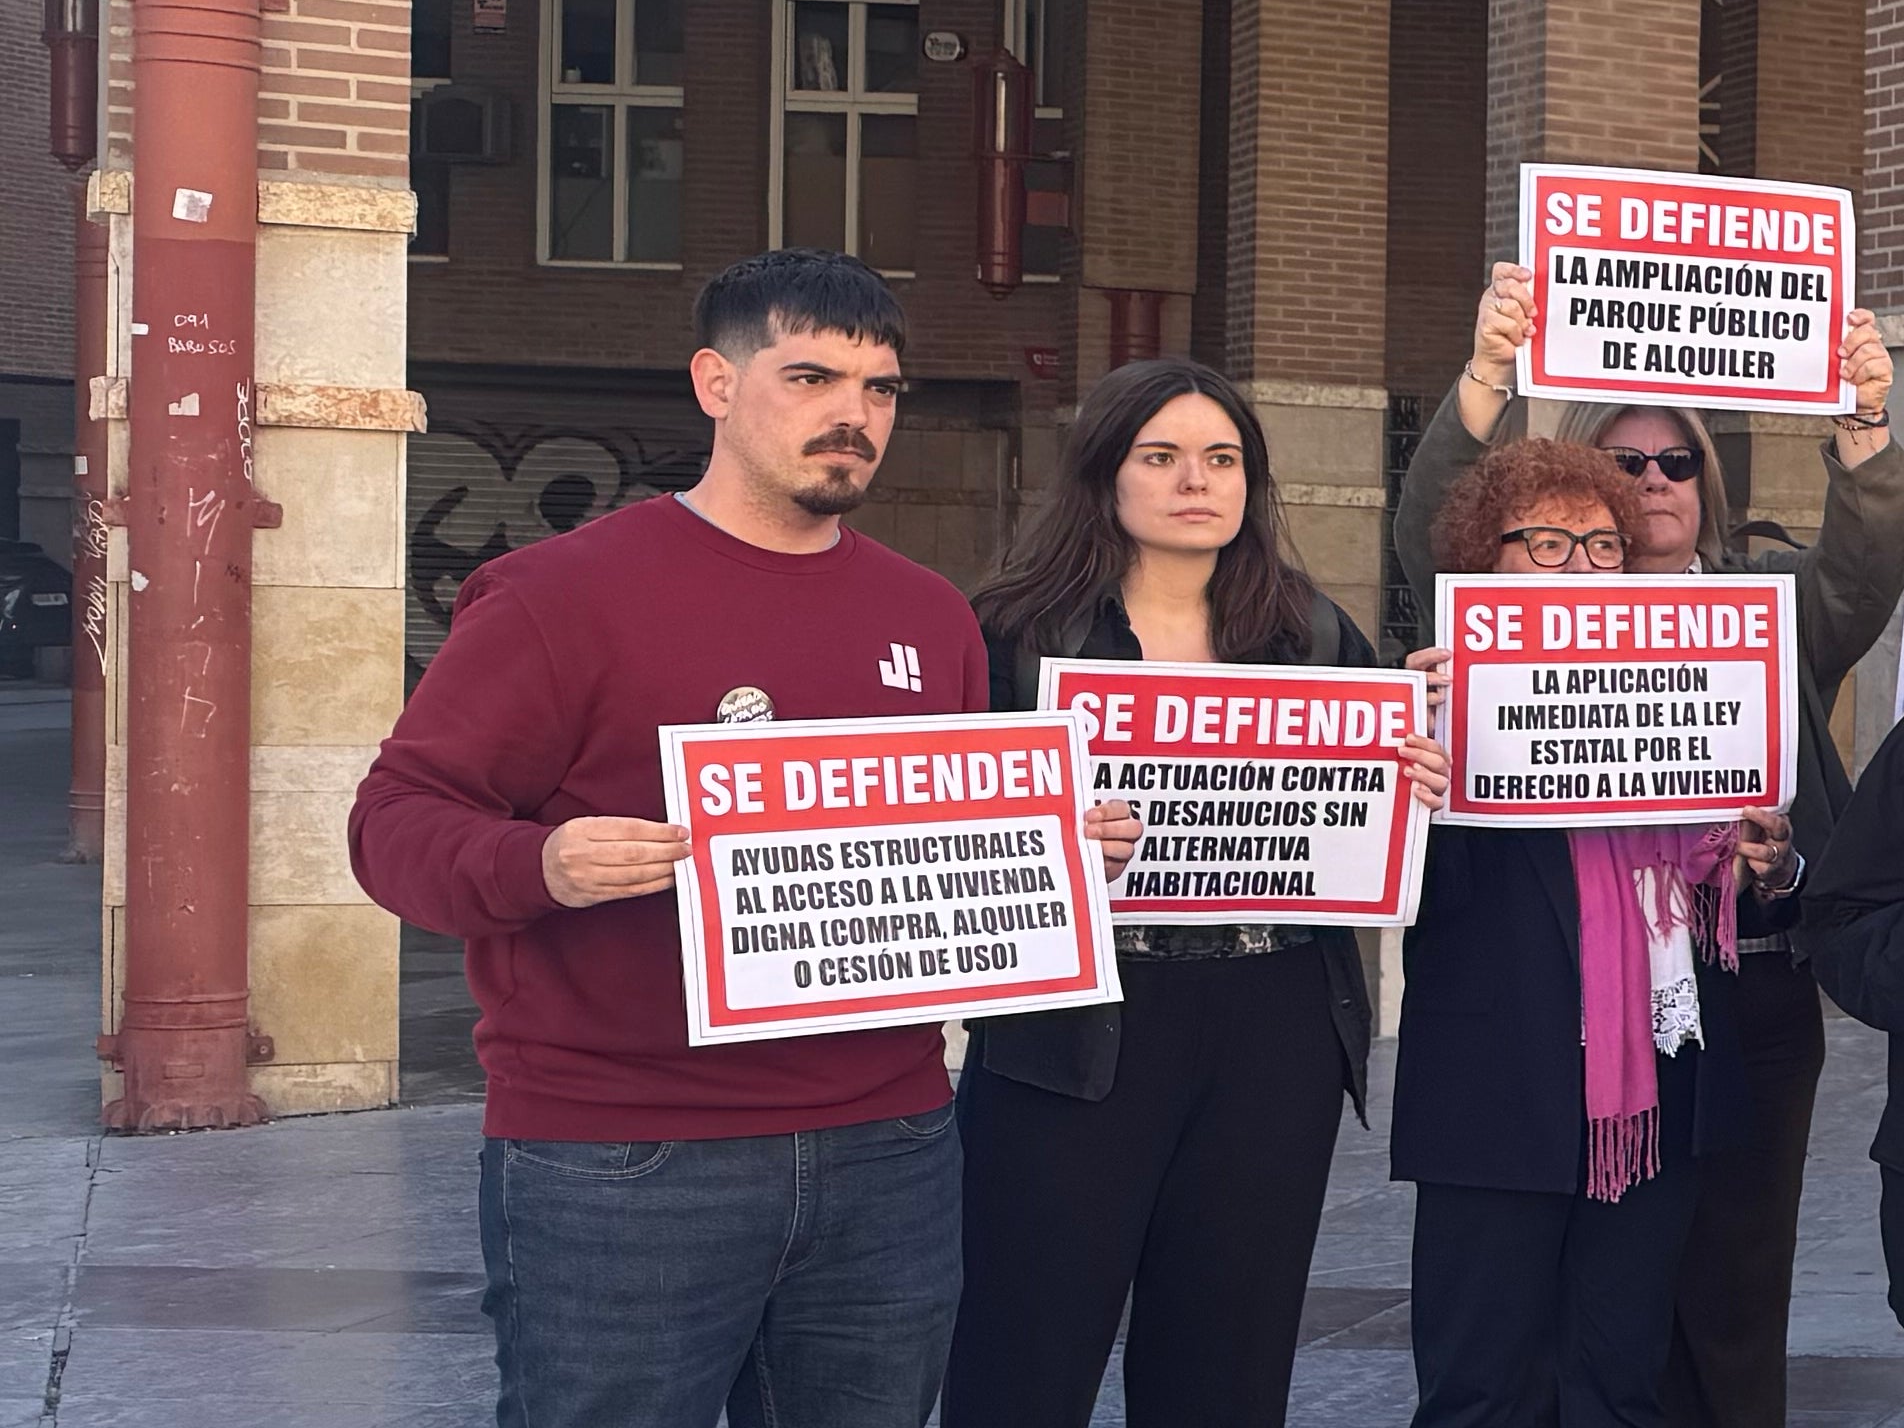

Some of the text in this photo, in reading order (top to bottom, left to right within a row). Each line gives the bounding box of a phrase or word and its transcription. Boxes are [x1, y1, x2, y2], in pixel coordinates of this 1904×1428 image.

[1546, 192, 1835, 255] SE DEFIENDE
[1555, 255, 1827, 302] LA AMPLIACIÓN DEL
[1569, 298, 1809, 341] PARQUE PÚBLICO
[1603, 341, 1775, 379] DE ALQUILER
[1464, 604, 1769, 651] SE DEFIENDE
[1532, 664, 1708, 694] LA APLICACIÓN
[1071, 693, 1406, 747] SE DEFIENDE
[1499, 701, 1741, 730] INMEDIATA DE LA LEY
[1531, 736, 1711, 765] ESTATAL POR EL
[700, 748, 1063, 816] SE DEFIENDEN
[1474, 769, 1762, 799] DERECHO A LA VIVIENDA
